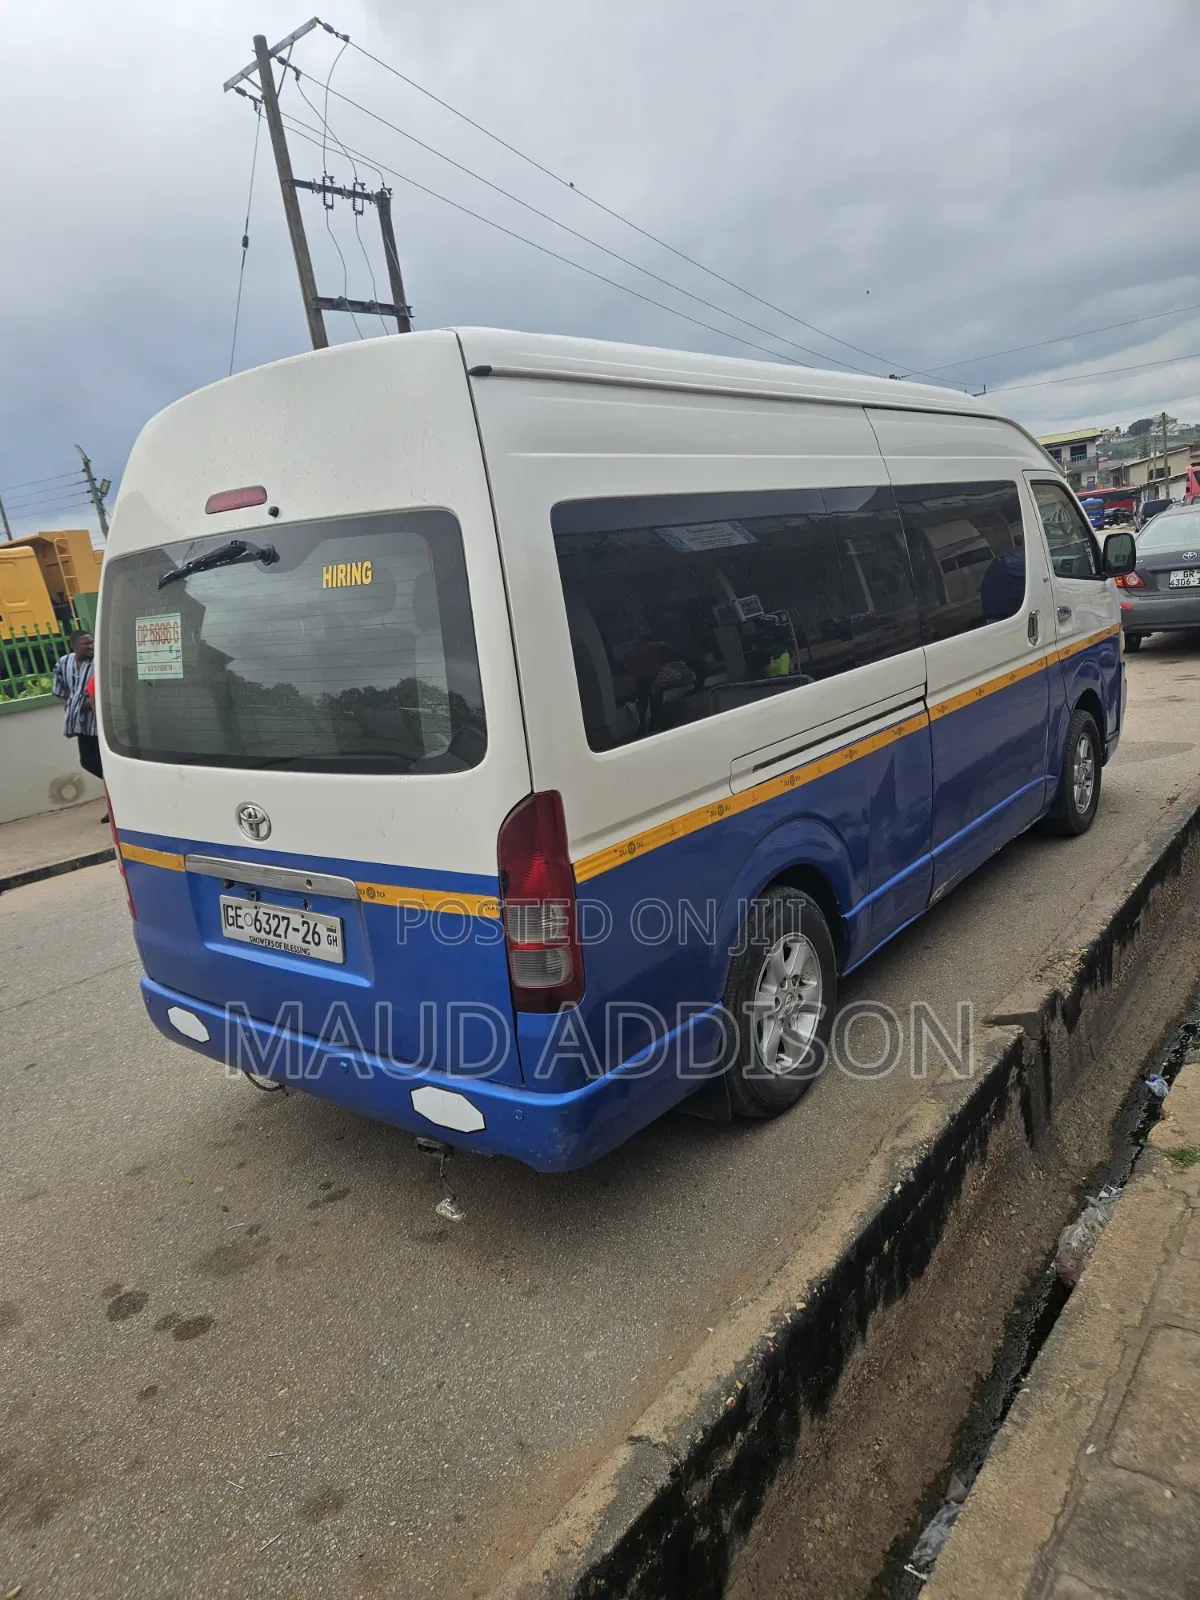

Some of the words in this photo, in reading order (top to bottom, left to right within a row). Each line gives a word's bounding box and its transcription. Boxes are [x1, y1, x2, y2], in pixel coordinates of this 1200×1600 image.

[322, 560, 372, 589] HIRING
[225, 904, 245, 930] GE
[253, 910, 321, 947] 6327-26
[249, 935, 275, 948] SHOWERS
[274, 941, 282, 950] OF
[283, 943, 311, 956] BLESSING
[326, 934, 338, 947] GH
